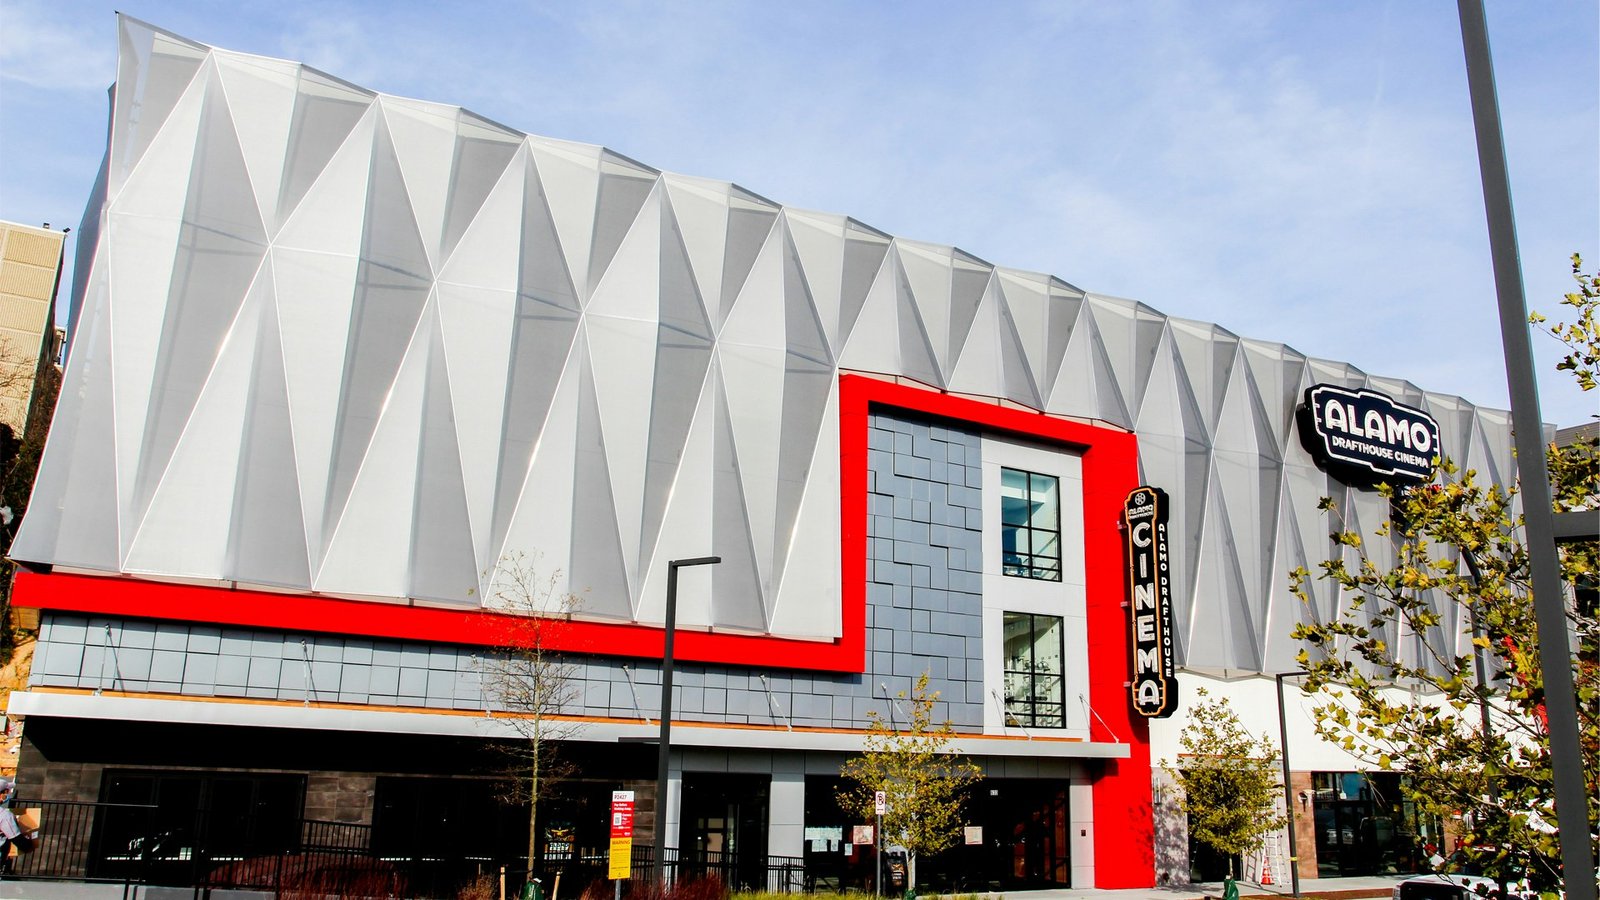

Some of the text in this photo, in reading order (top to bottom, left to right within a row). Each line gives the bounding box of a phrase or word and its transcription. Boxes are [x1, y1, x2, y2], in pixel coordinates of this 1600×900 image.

[1324, 399, 1431, 452] ALAMO
[1332, 435, 1429, 468] DRAFTHOUSE CINEMA
[1132, 521, 1160, 706] CINEMA
[1158, 523, 1172, 678] ALAMO DRAFTHOUSE
